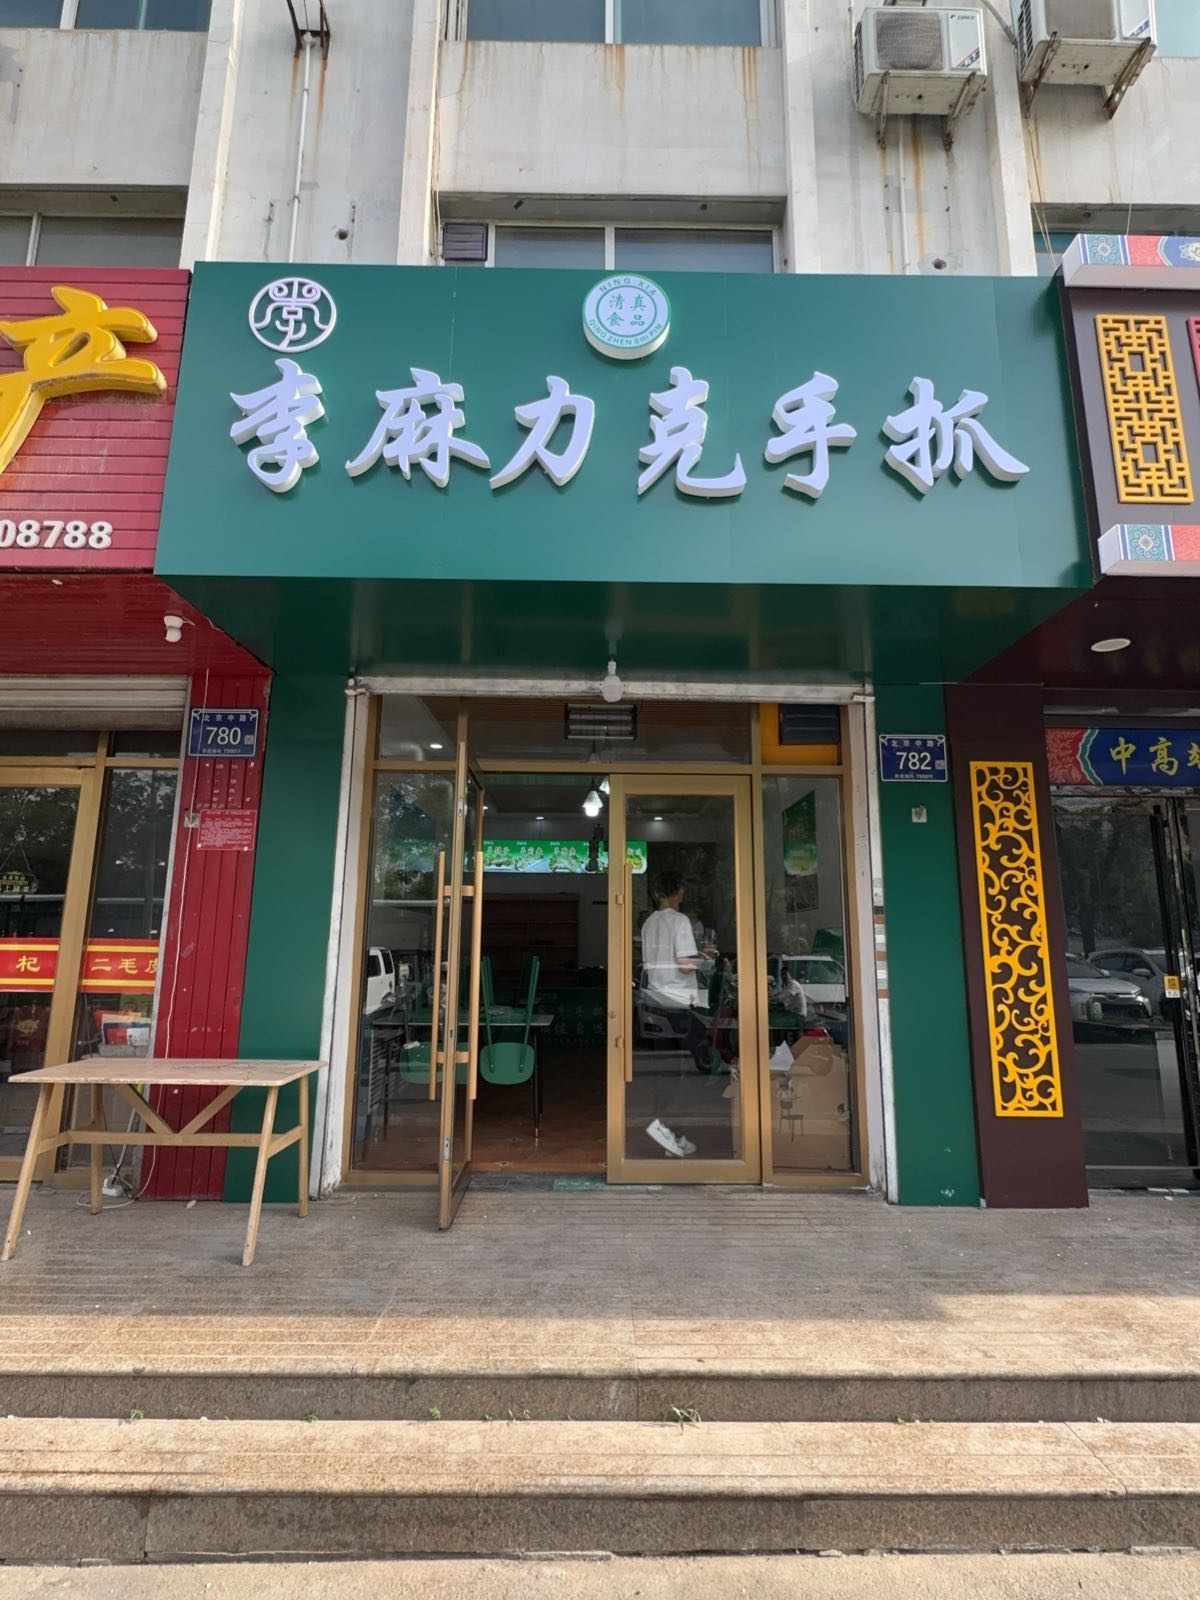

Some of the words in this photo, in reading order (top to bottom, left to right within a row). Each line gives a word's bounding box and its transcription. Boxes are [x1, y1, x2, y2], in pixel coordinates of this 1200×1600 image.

[600, 277, 631, 293] NING
[638, 280, 656, 296] XIA
[609, 293, 647, 312] 清真
[606, 311, 646, 327] 食品
[589, 319, 607, 337] QING
[608, 335, 632, 346] ZHEN
[229, 358, 1030, 500] 李麻力克手抓
[202, 714, 247, 722] 北京中路
[206, 726, 241, 745] 780
[890, 739, 935, 748] 北京中路
[895, 751, 932, 770] 782
[15, 955, 41, 973] 杞
